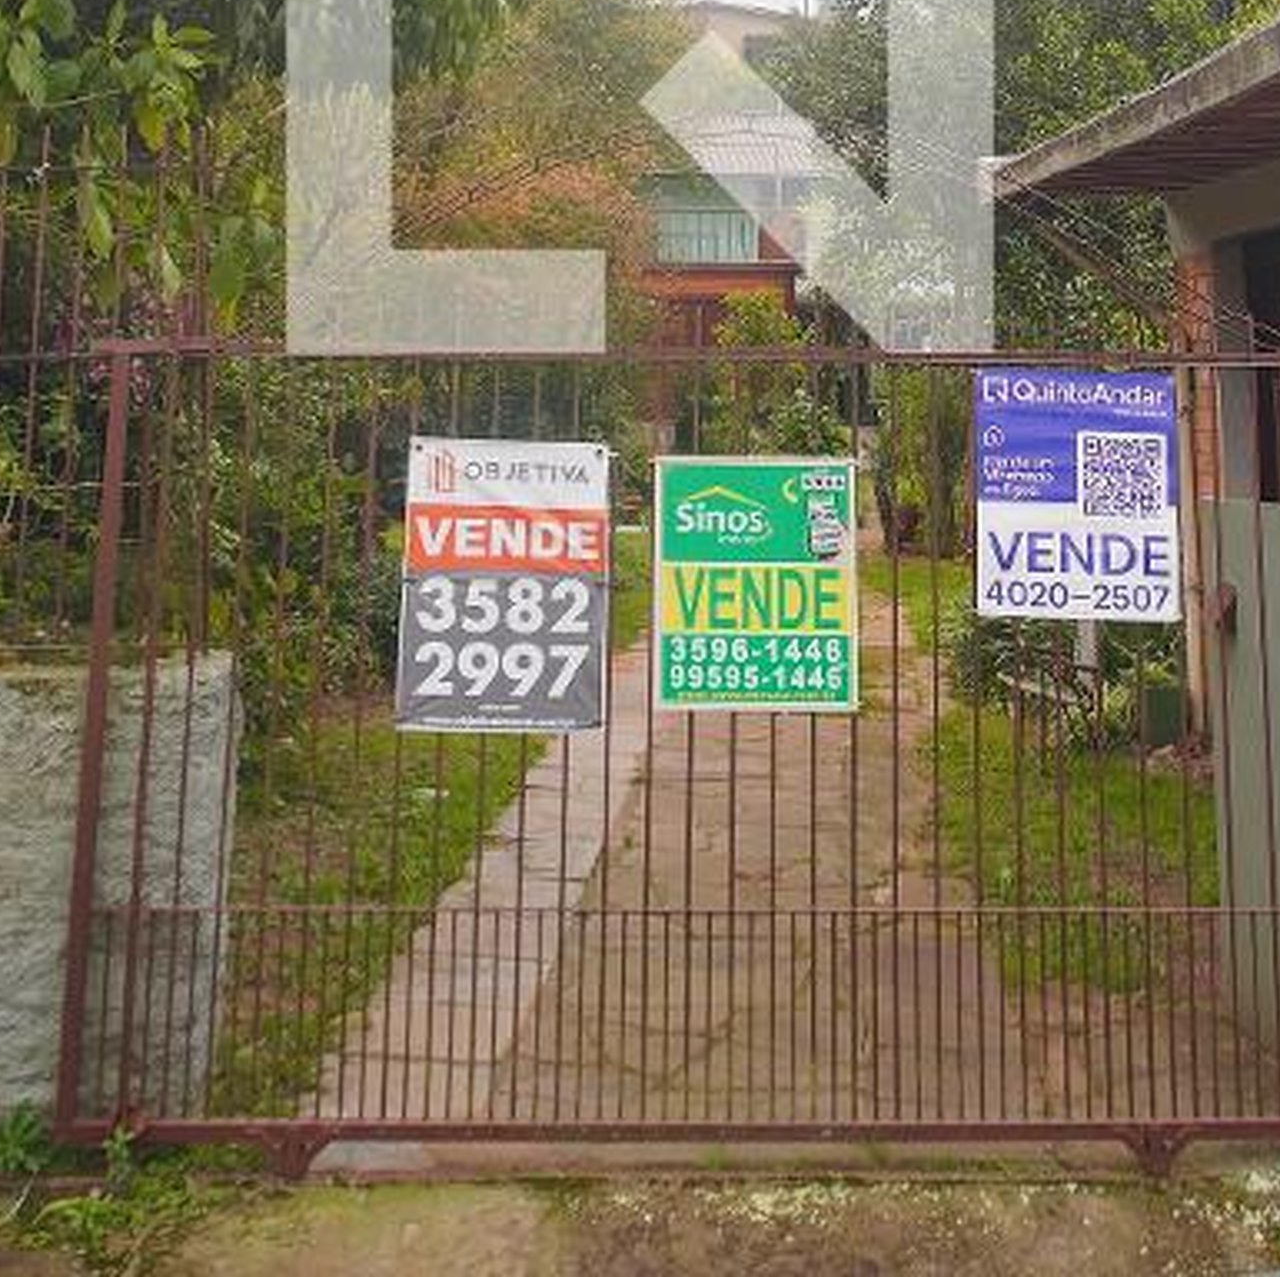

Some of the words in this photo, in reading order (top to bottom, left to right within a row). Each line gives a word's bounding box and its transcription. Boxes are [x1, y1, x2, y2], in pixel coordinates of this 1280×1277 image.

[1013, 378, 1165, 406] QuintoAndar
[464, 462, 588, 484] OBJETIVA
[675, 502, 764, 534] Sinos
[415, 517, 599, 560] VENDE
[987, 531, 1170, 577] VENDE
[416, 577, 589, 634] 3582
[674, 568, 840, 629] VENDE
[986, 581, 1170, 612] 4020-2507
[412, 641, 589, 699] 2997
[670, 664, 842, 689] 99595-1446
